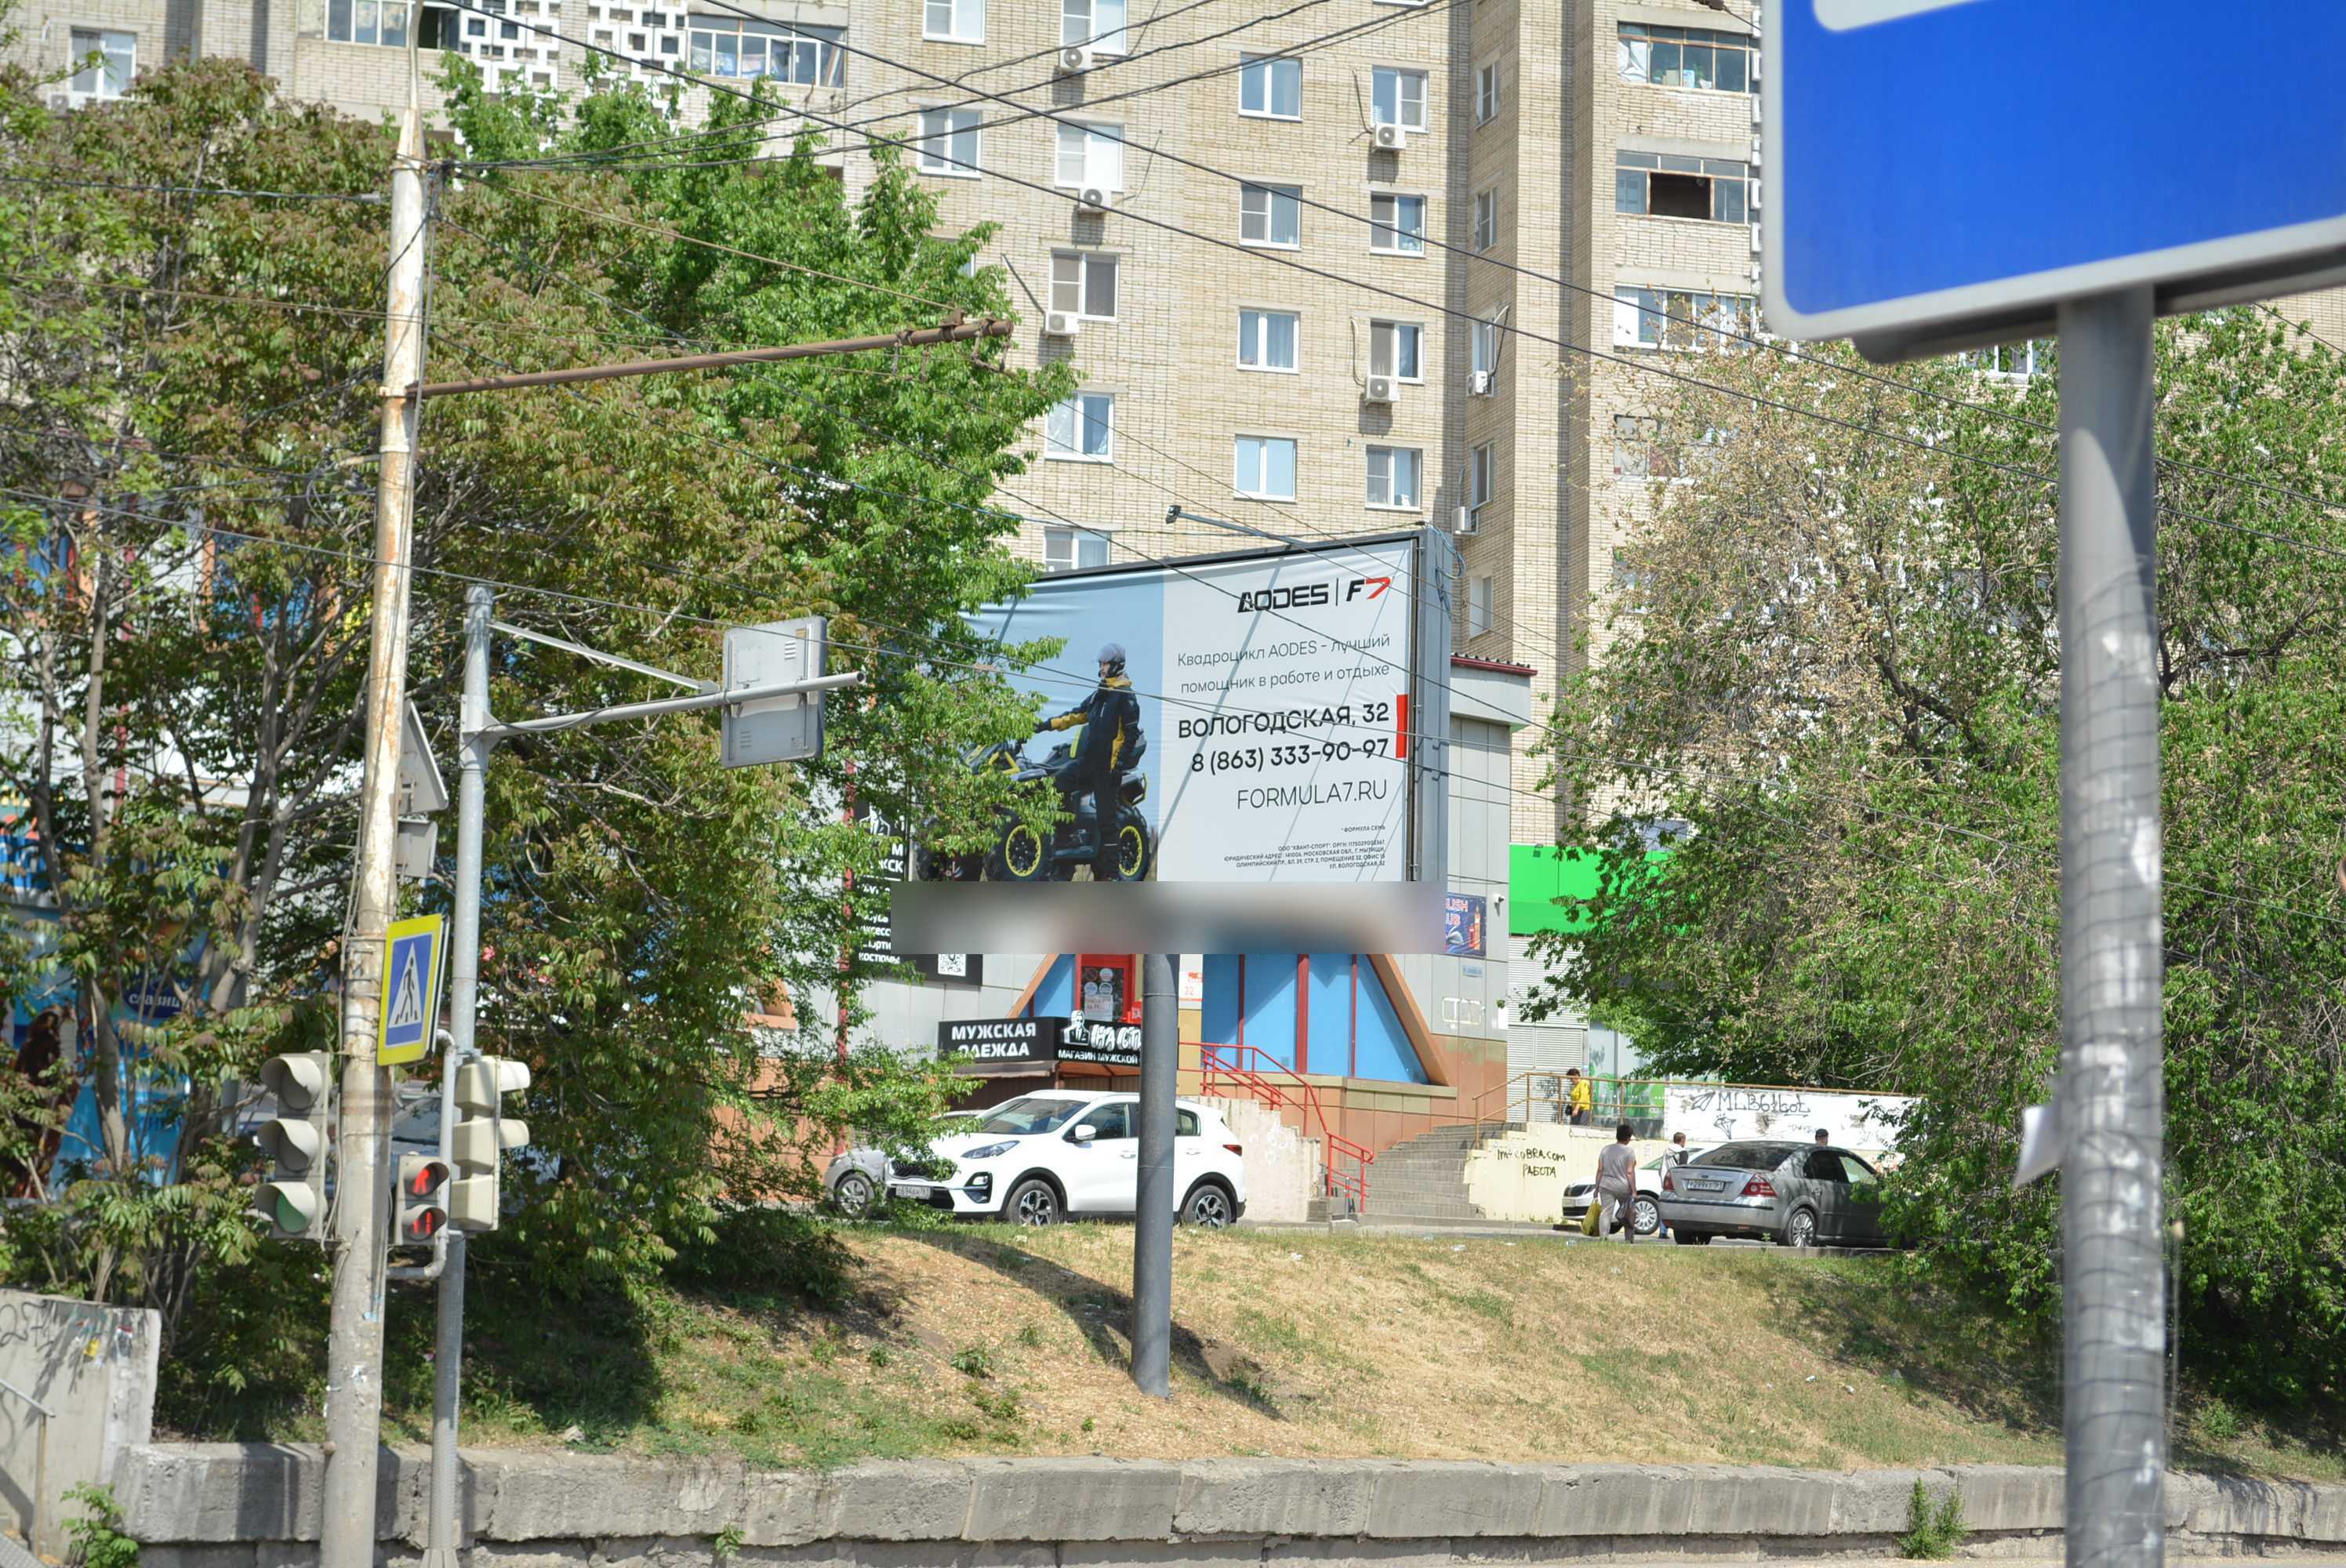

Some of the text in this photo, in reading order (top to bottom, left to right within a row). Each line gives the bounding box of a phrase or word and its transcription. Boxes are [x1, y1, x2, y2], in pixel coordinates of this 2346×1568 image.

[1237, 576, 1392, 613] AODES F7
[1178, 648, 1266, 667] Квадроцикл
[1268, 640, 1317, 658] AODES
[1331, 633, 1390, 654] лучший
[1181, 664, 1390, 694] помощник в работе и отдыхе
[1178, 702, 1389, 739] ВОЛОГОДСКАЯ, 32
[1191, 738, 1389, 776] 8 (863) 333-90-97
[1237, 779, 1387, 810] FORMULA7.RU
[951, 1022, 1037, 1040] МУЖСКАЯ
[957, 1042, 1030, 1059] ОДЕЖДА
[1059, 1049, 1138, 1065] МАГАЗИН МУЖСКОЙ
[1523, 1163, 1556, 1178] РАБОТА
